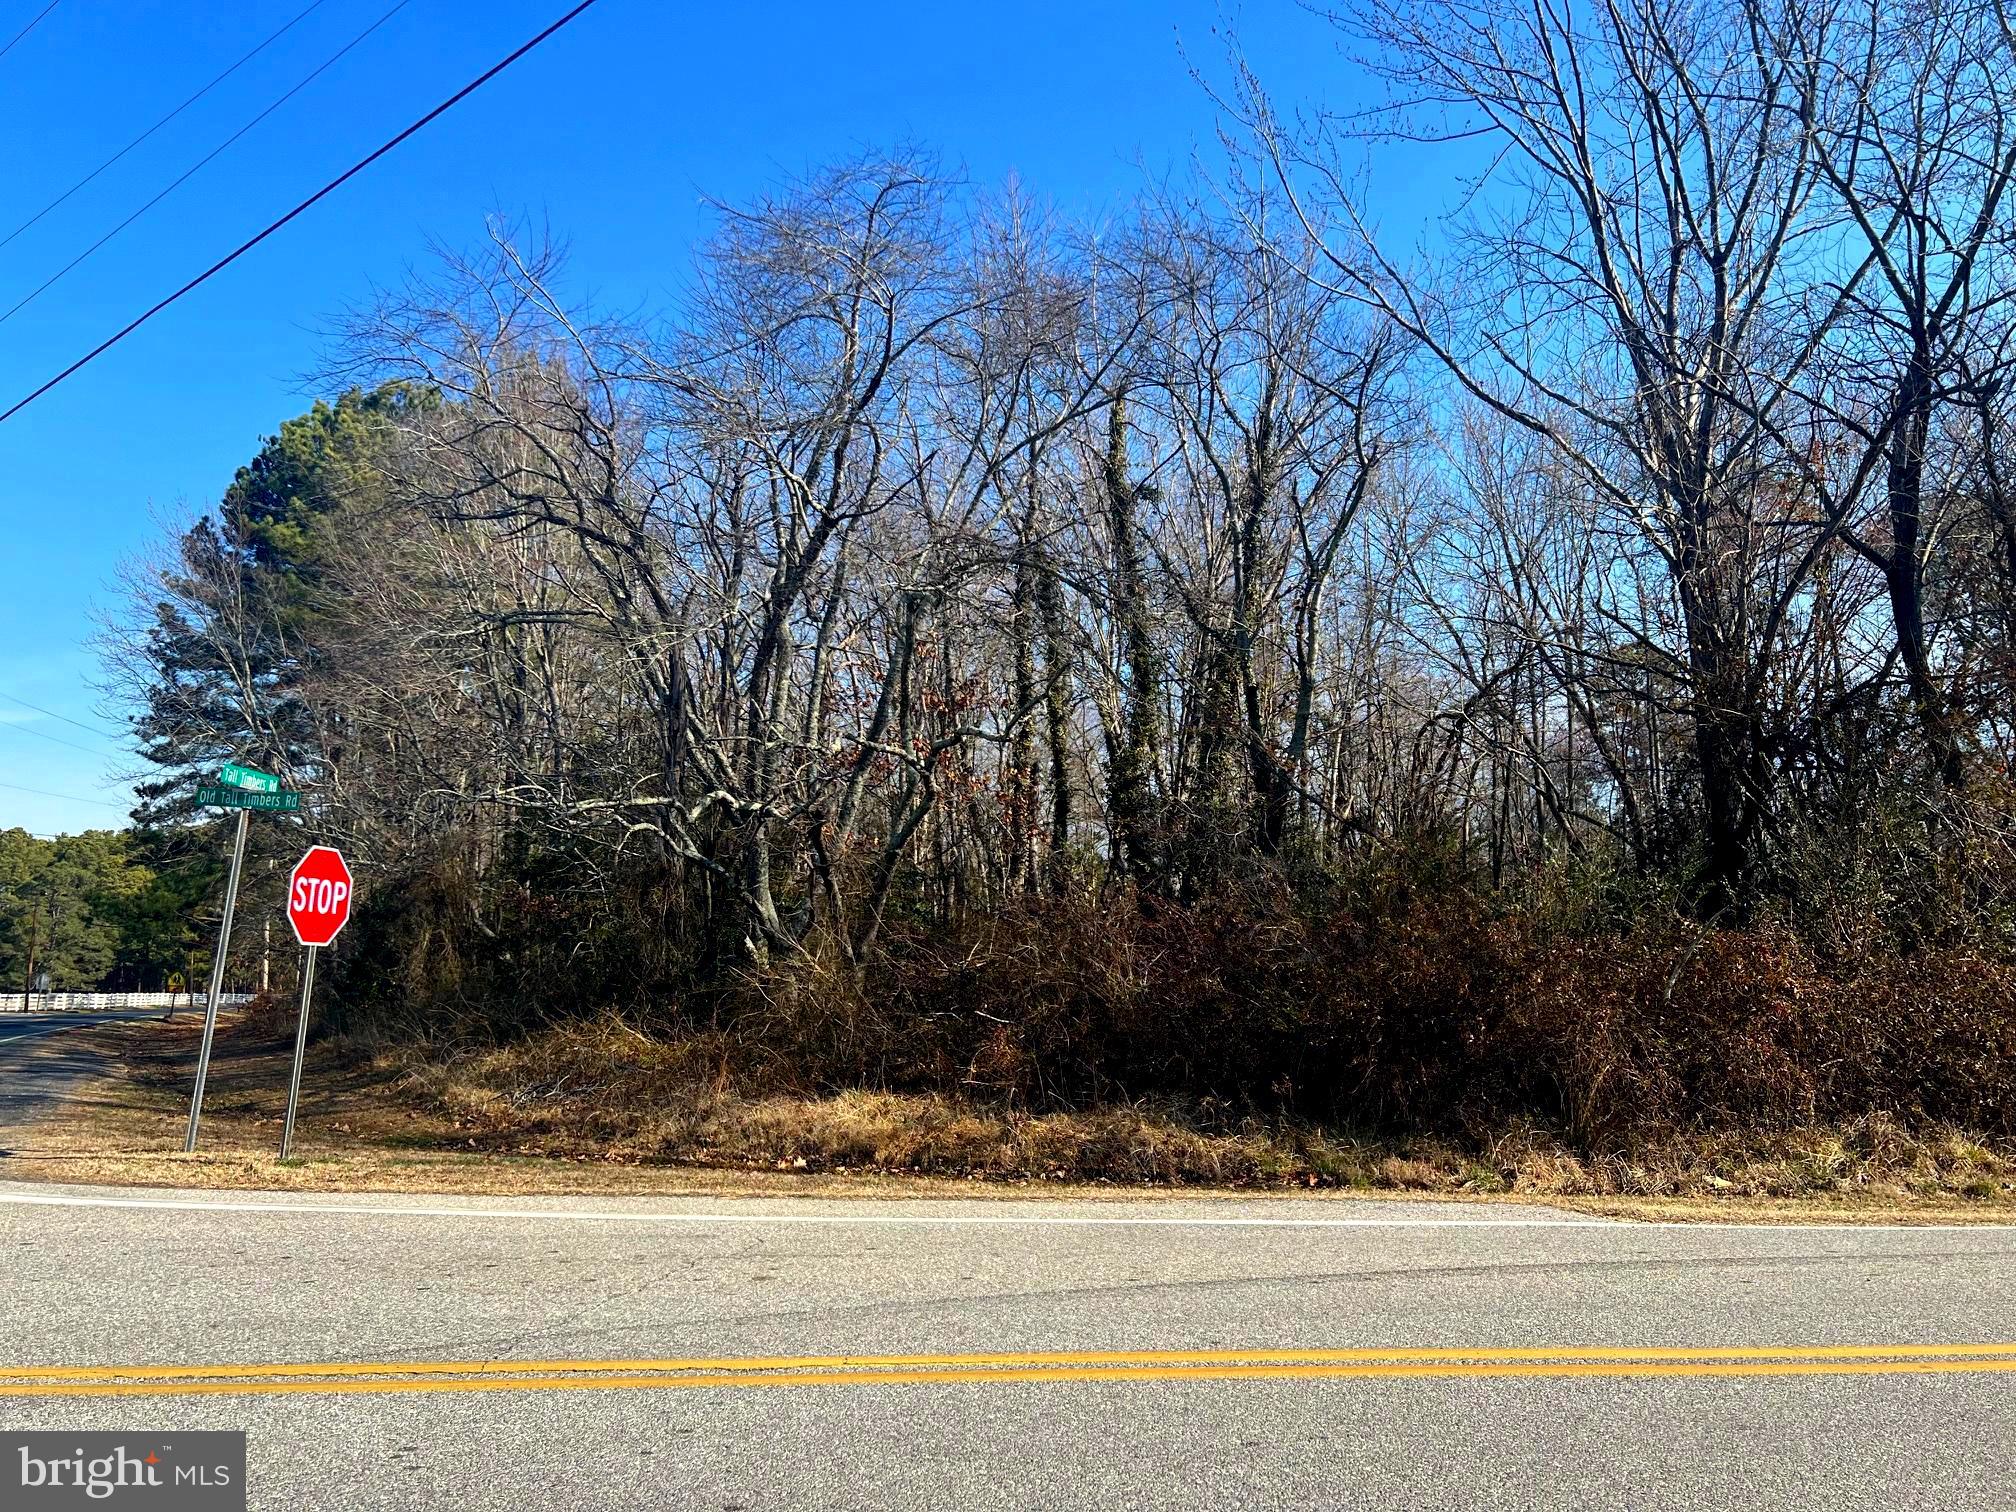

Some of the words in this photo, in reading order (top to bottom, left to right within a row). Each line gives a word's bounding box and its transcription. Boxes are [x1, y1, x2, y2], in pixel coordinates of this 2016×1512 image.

[225, 768, 238, 783] Tall
[241, 772, 266, 790] Timbers
[269, 780, 278, 792] Rd
[200, 790, 216, 803] Old
[221, 791, 238, 805] Tall
[243, 792, 281, 807] Timbers
[285, 794, 298, 808] Rd
[293, 876, 348, 915] STOP
